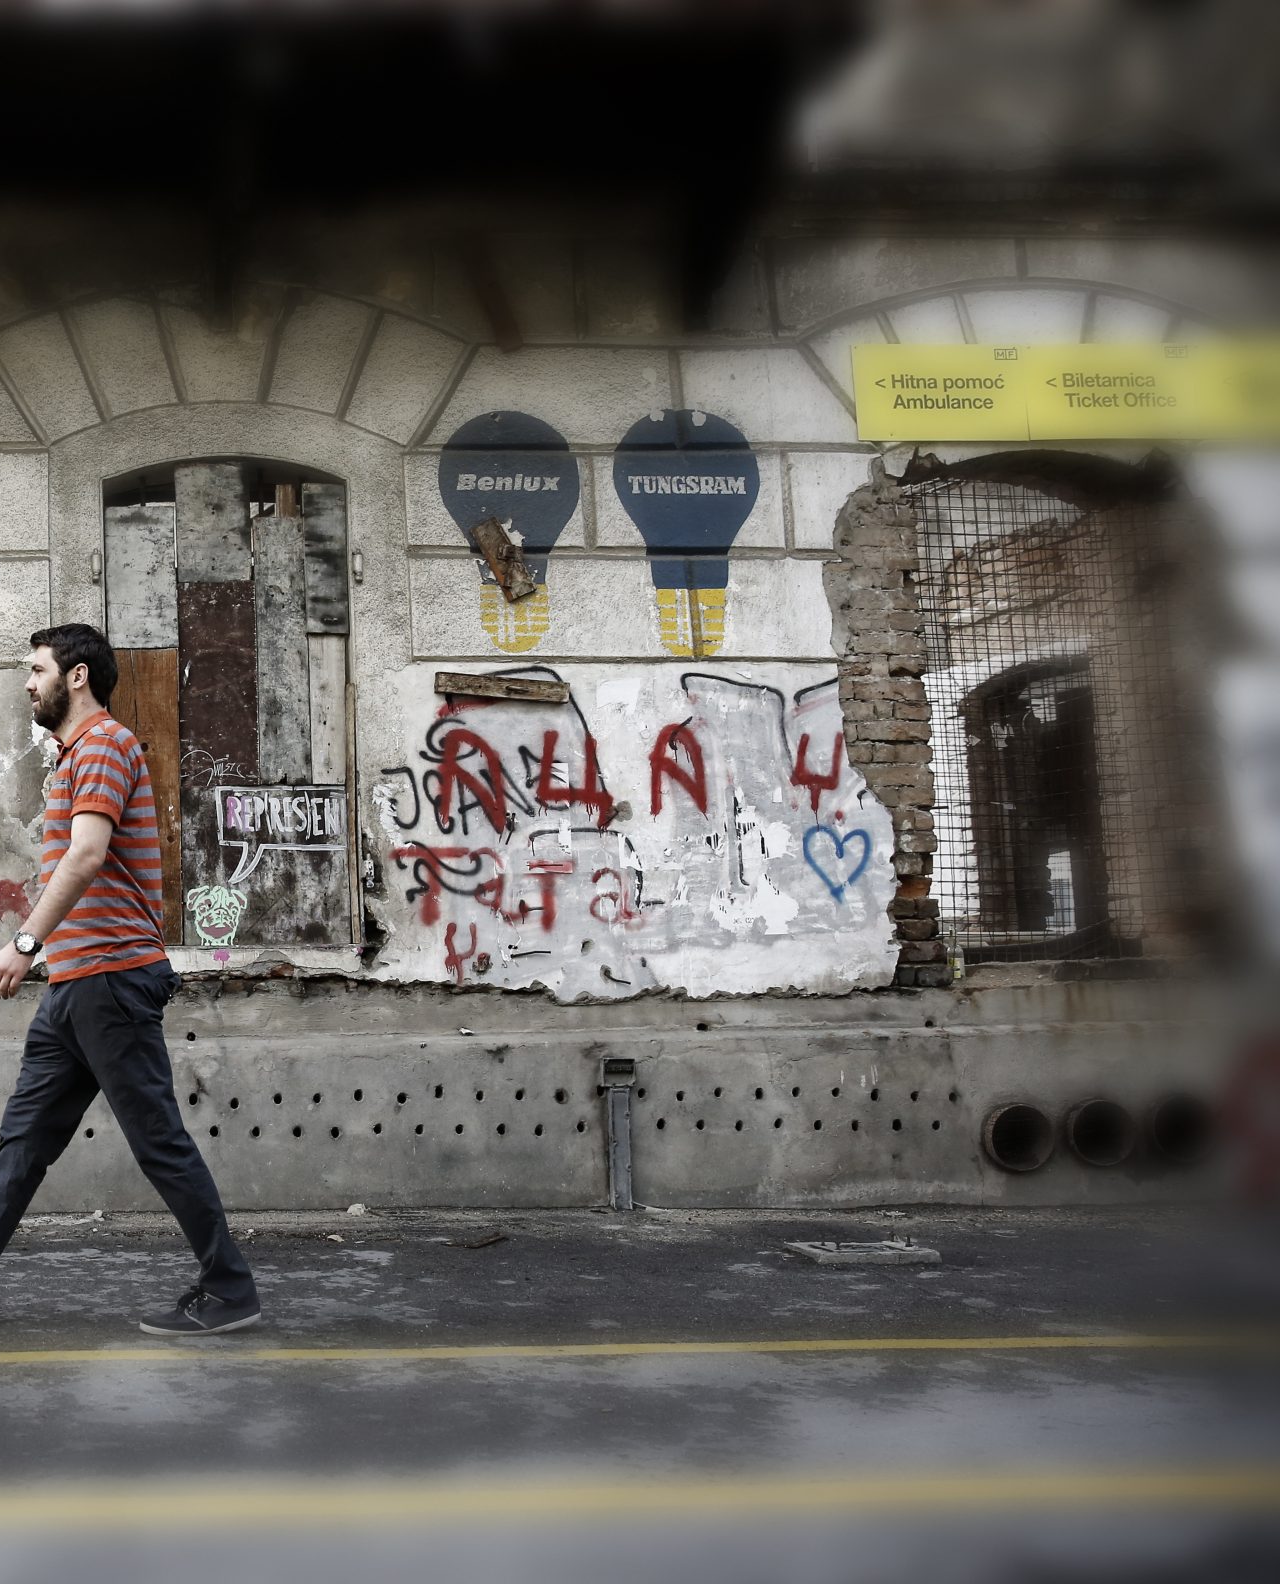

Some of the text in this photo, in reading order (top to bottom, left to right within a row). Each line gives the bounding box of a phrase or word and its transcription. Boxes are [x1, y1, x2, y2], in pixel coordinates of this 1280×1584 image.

[890, 374, 1005, 392] Hitna pomoć
[1062, 372, 1156, 388] Biletarnica
[893, 394, 994, 409] Ambulance
[1064, 392, 1177, 408] Ticket Office
[456, 473, 561, 492] Benlux
[628, 475, 747, 495] TUNGSRAM
